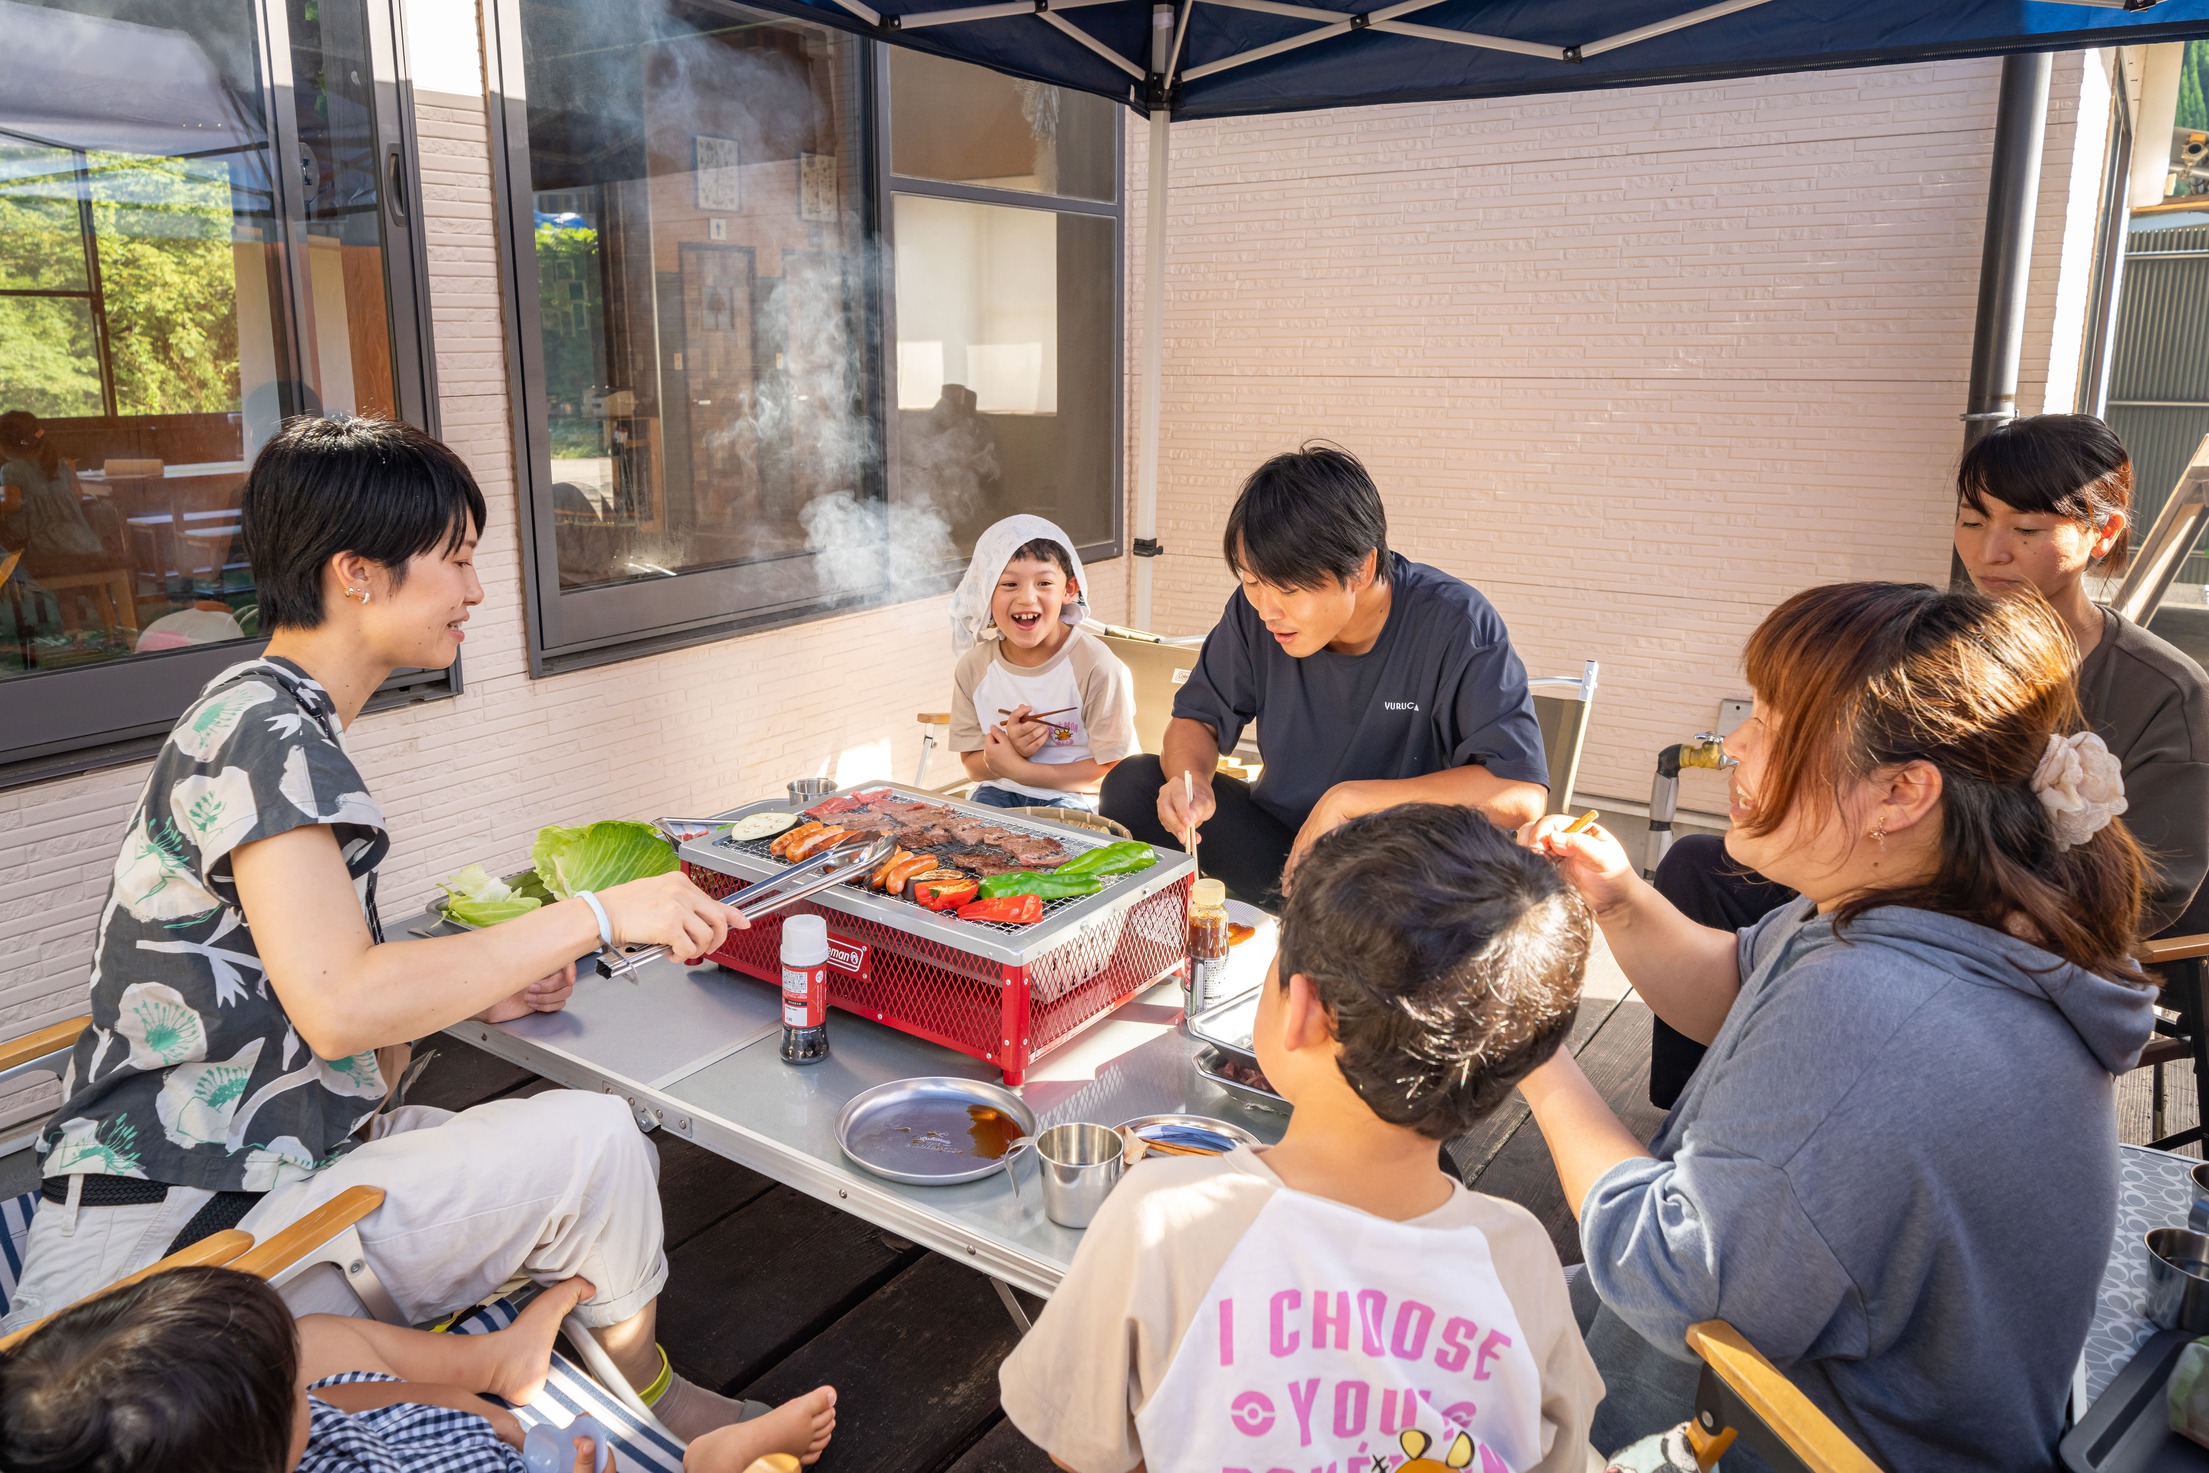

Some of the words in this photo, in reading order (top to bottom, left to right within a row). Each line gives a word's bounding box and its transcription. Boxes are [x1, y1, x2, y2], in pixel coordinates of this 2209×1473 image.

[1384, 701, 1420, 711] YURUCA
[1219, 1298, 1234, 1366] I
[1269, 1288, 1512, 1381] CHOOSE
[1287, 1378, 1431, 1447] YOU
